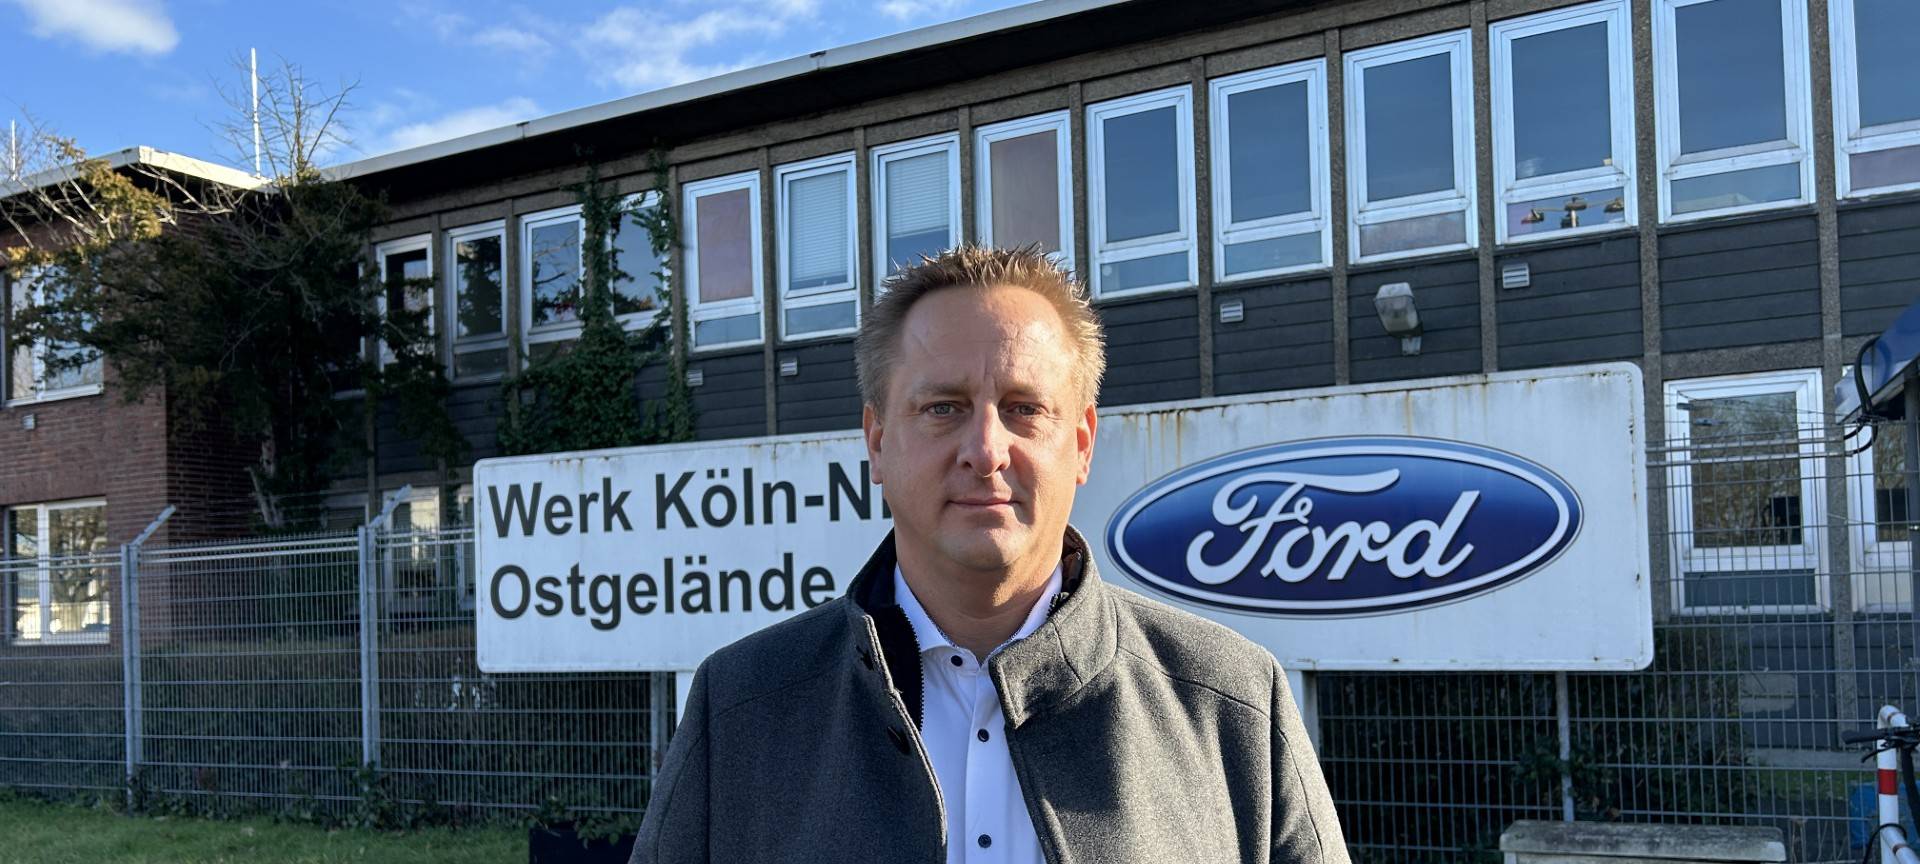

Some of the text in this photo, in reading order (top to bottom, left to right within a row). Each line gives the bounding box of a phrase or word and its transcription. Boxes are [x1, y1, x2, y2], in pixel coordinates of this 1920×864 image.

[488, 476, 633, 538] Werk
[1186, 468, 1481, 584] Ford
[490, 552, 836, 630] Ostgelände
